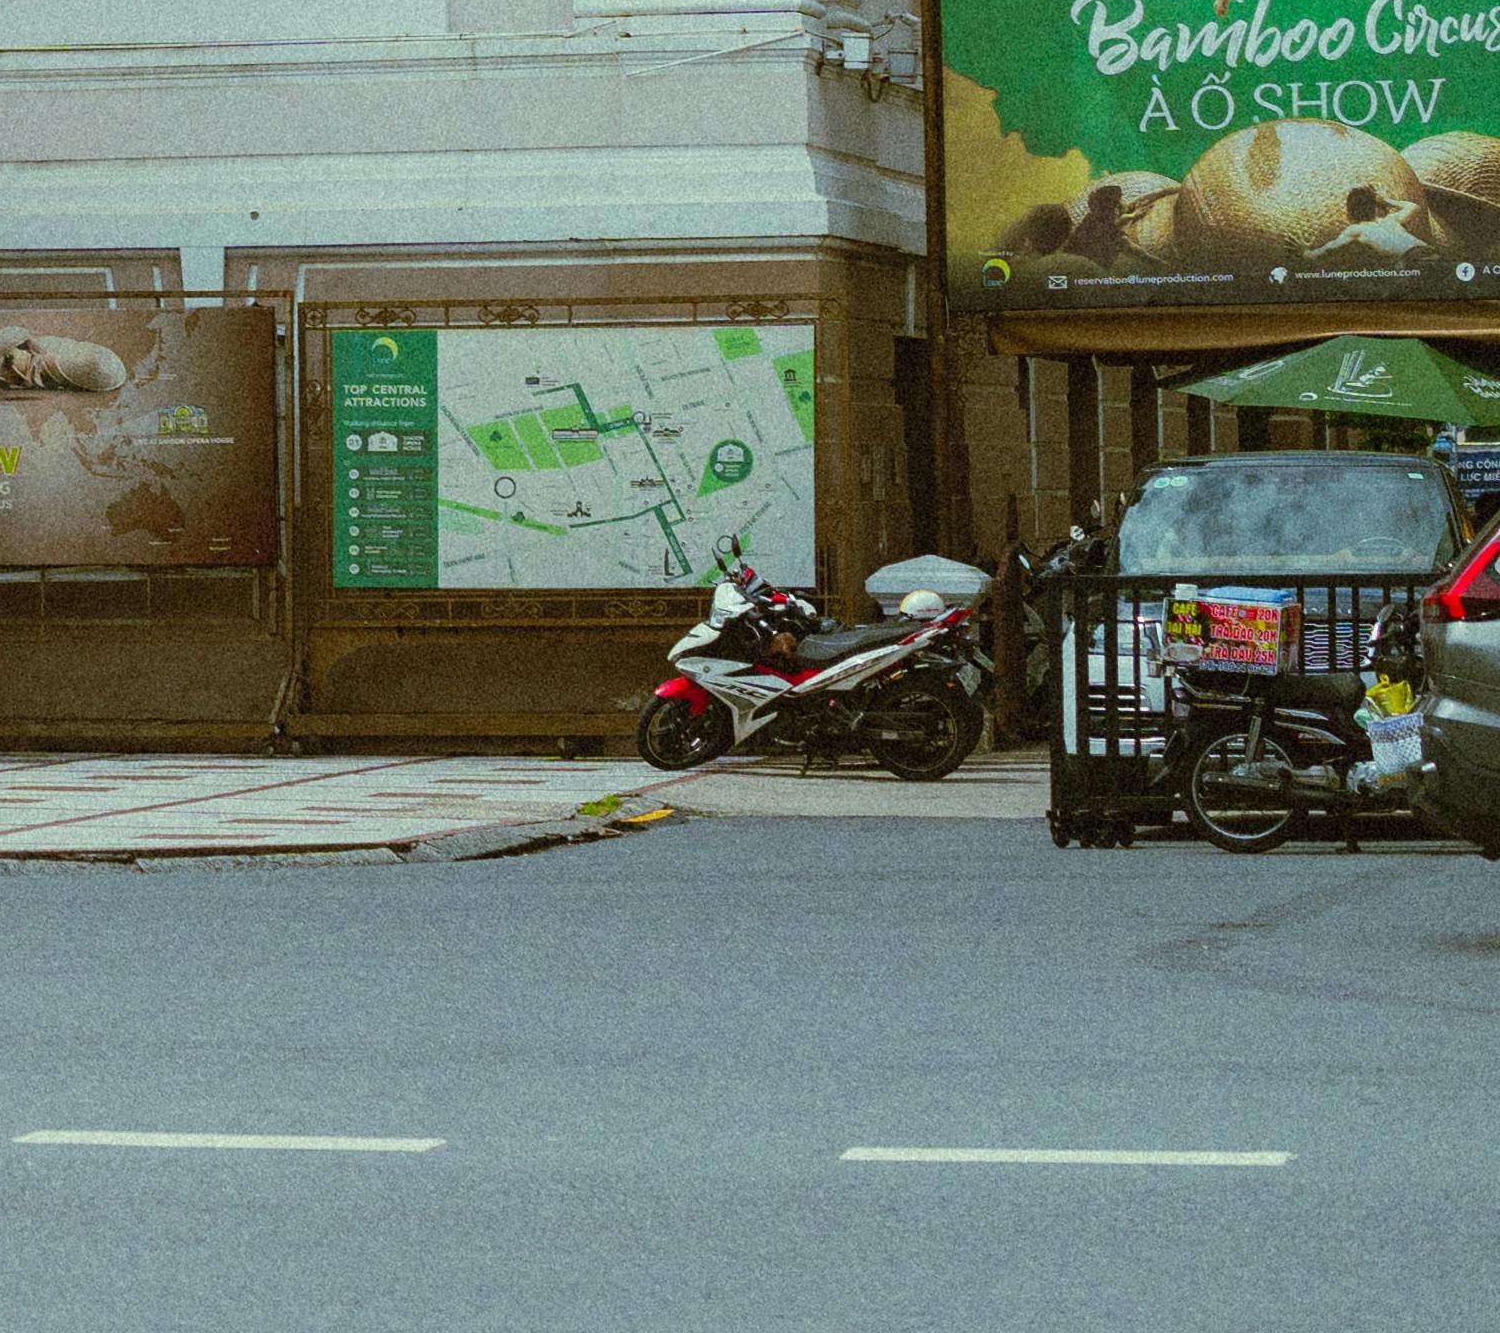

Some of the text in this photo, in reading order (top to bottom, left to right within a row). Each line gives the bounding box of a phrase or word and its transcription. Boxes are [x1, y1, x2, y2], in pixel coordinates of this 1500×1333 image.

[1139, 74, 1180, 133] À
[1252, 78, 1446, 126] SHOW
[343, 383, 428, 395] TOP CENTRAL
[344, 396, 428, 408] ATTRACTIONS
[1476, 457, 1500, 470] CÔN
